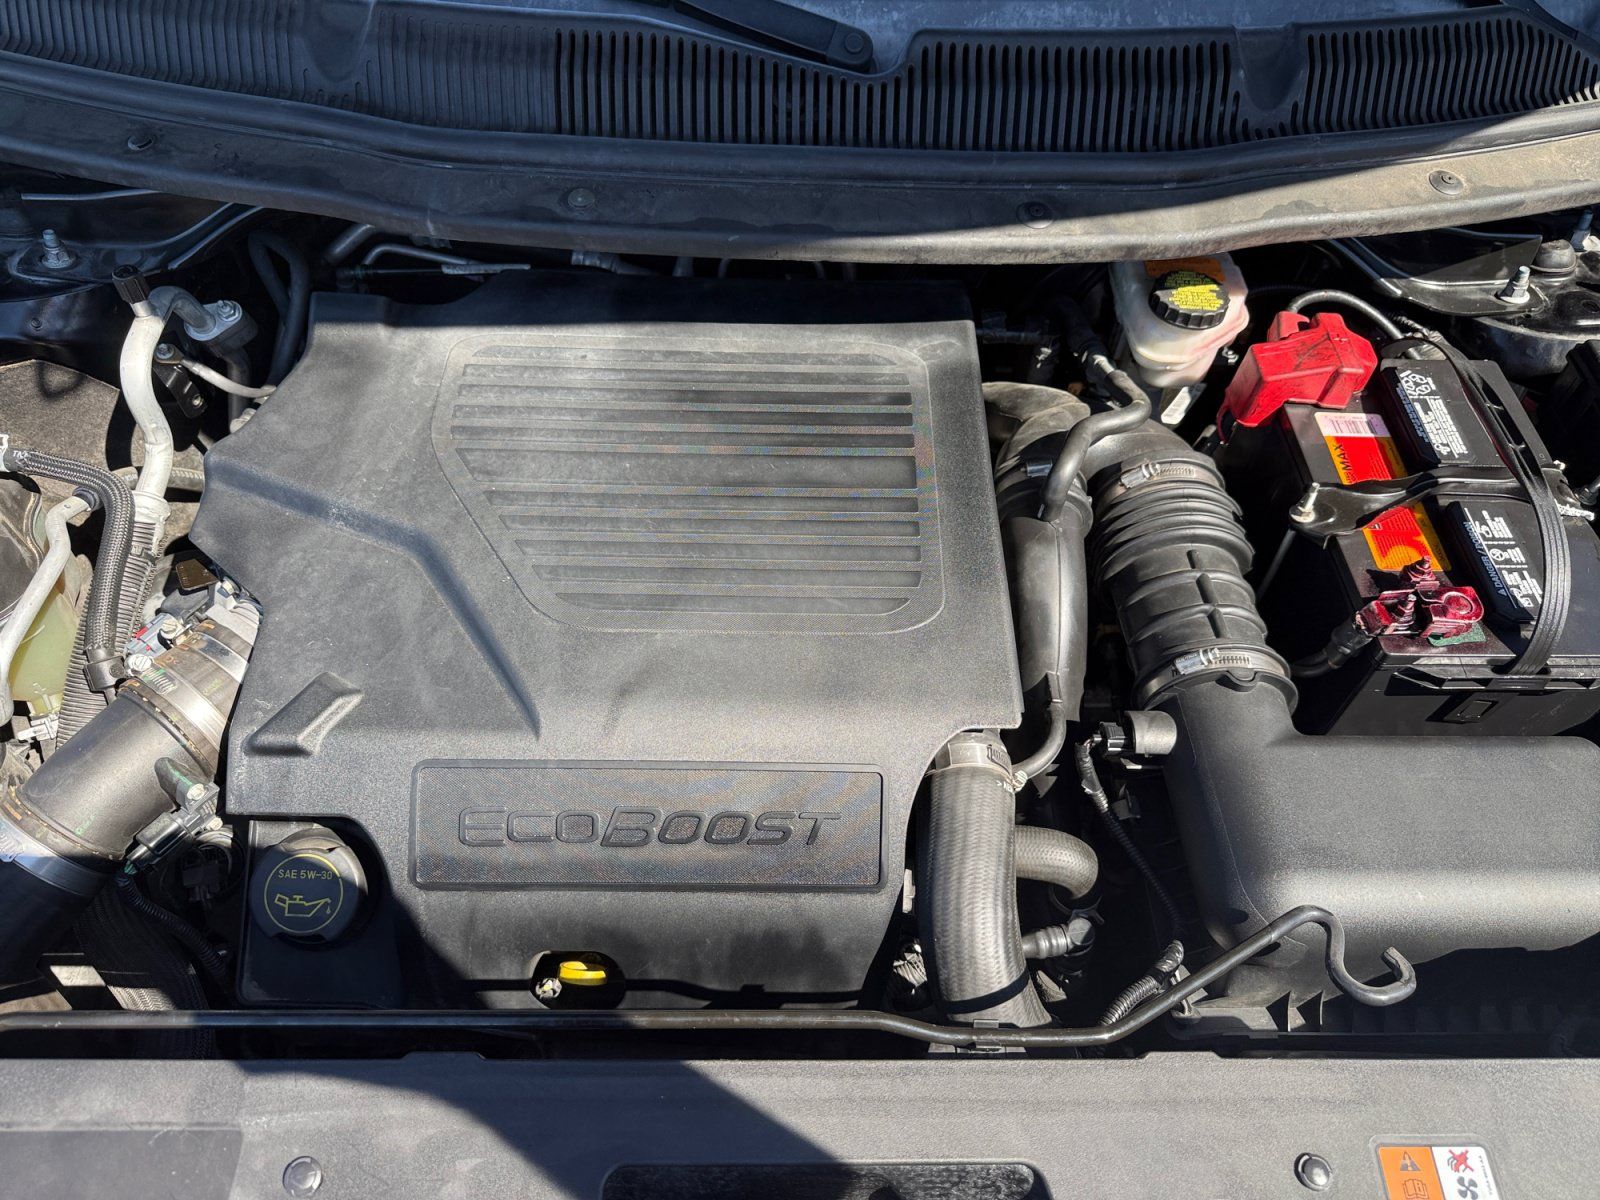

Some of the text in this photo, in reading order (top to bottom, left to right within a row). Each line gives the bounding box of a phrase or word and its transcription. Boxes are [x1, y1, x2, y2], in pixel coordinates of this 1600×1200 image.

[1332, 443, 1353, 471] MAX
[1463, 521, 1484, 549] POISON
[1481, 556, 1503, 588] DANGER
[458, 805, 842, 848] ECOBOOST
[278, 869, 333, 880] SAE 5W-30
